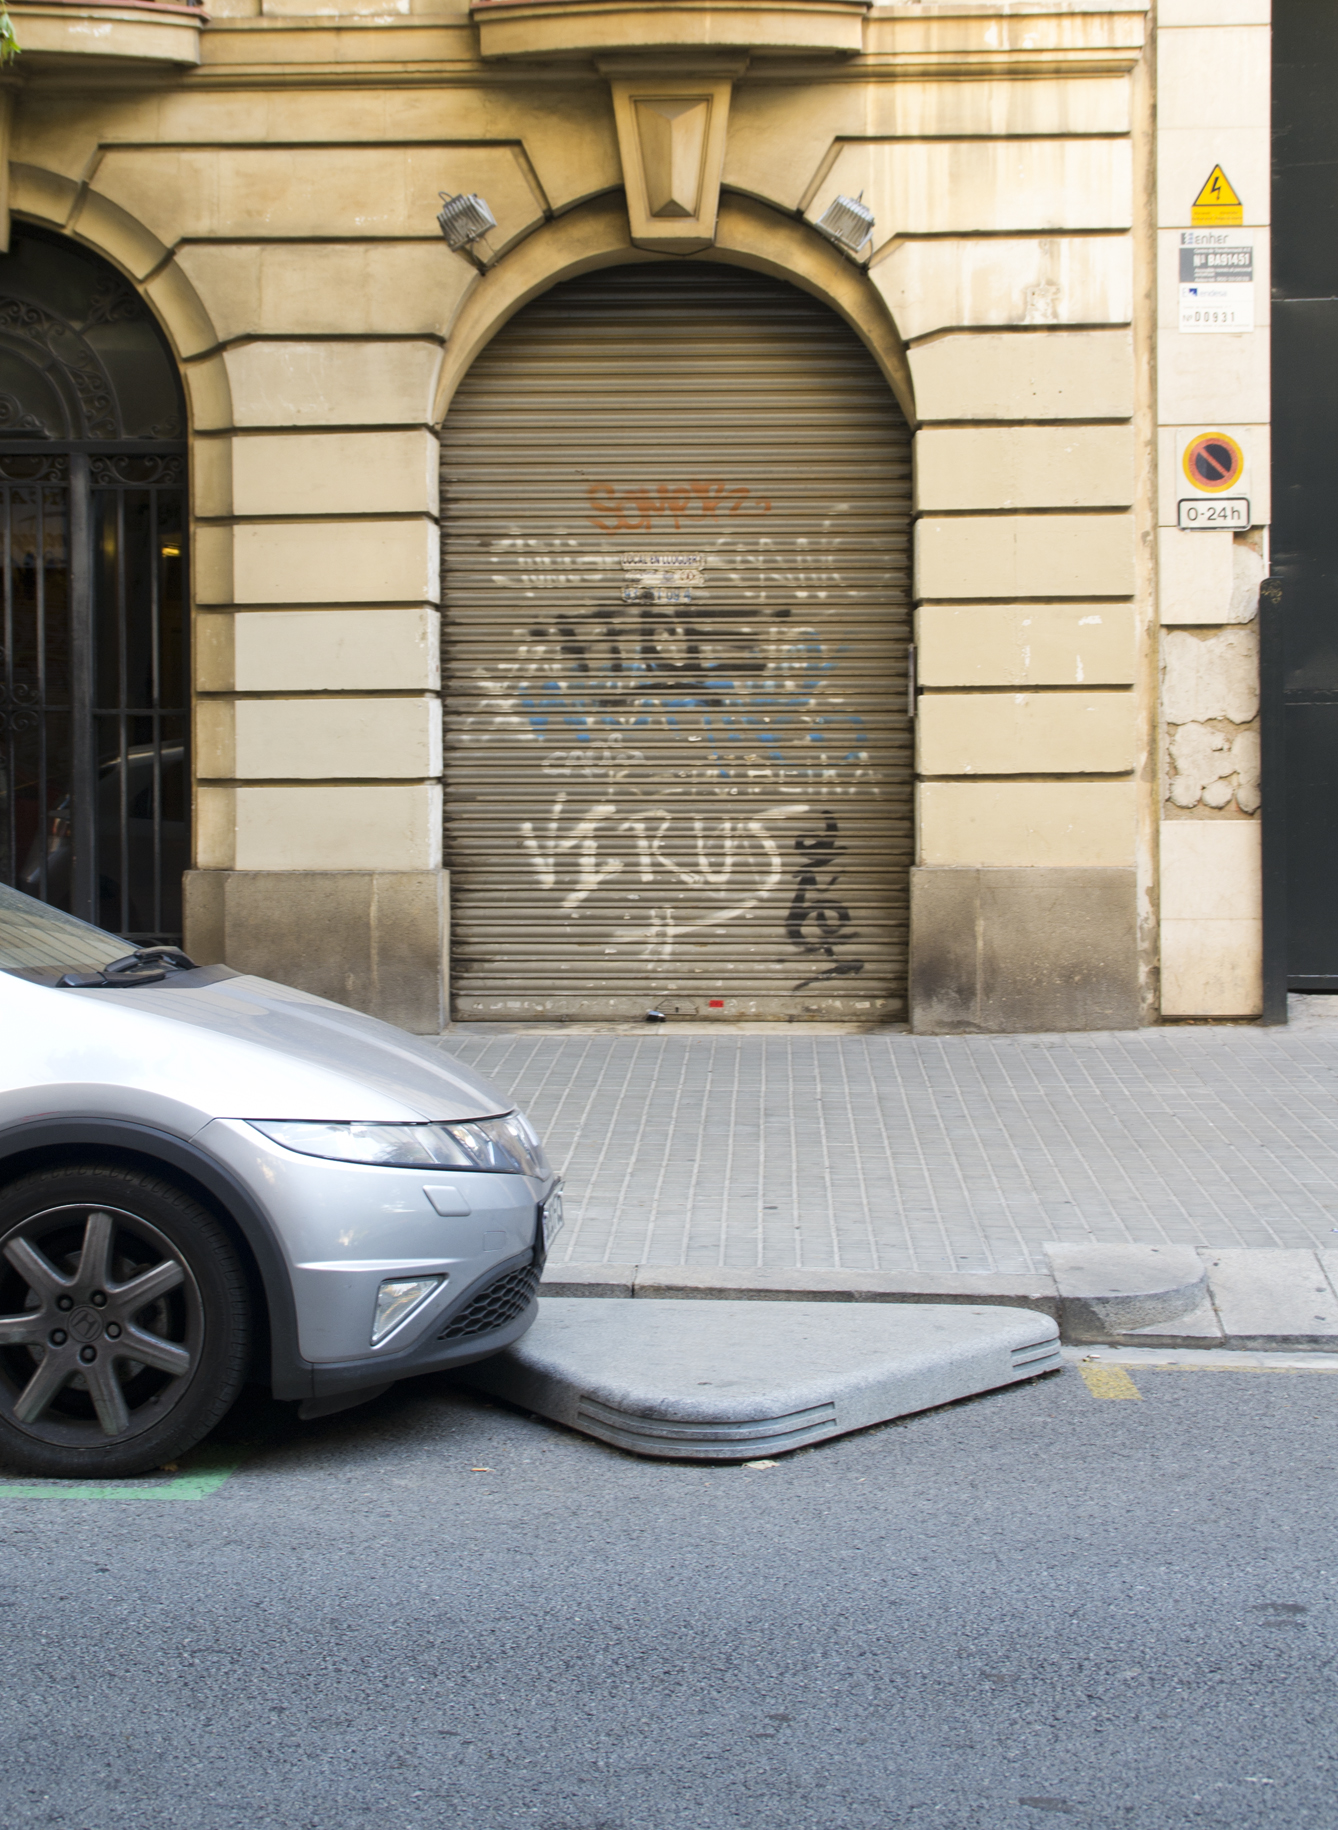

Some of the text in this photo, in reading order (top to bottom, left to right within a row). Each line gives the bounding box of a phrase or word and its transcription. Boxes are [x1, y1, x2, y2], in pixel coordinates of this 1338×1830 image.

[1194, 232, 1229, 245] enher
[1207, 253, 1250, 266] BA91451
[622, 554, 648, 565] LOCAL
[650, 554, 660, 565] EN
